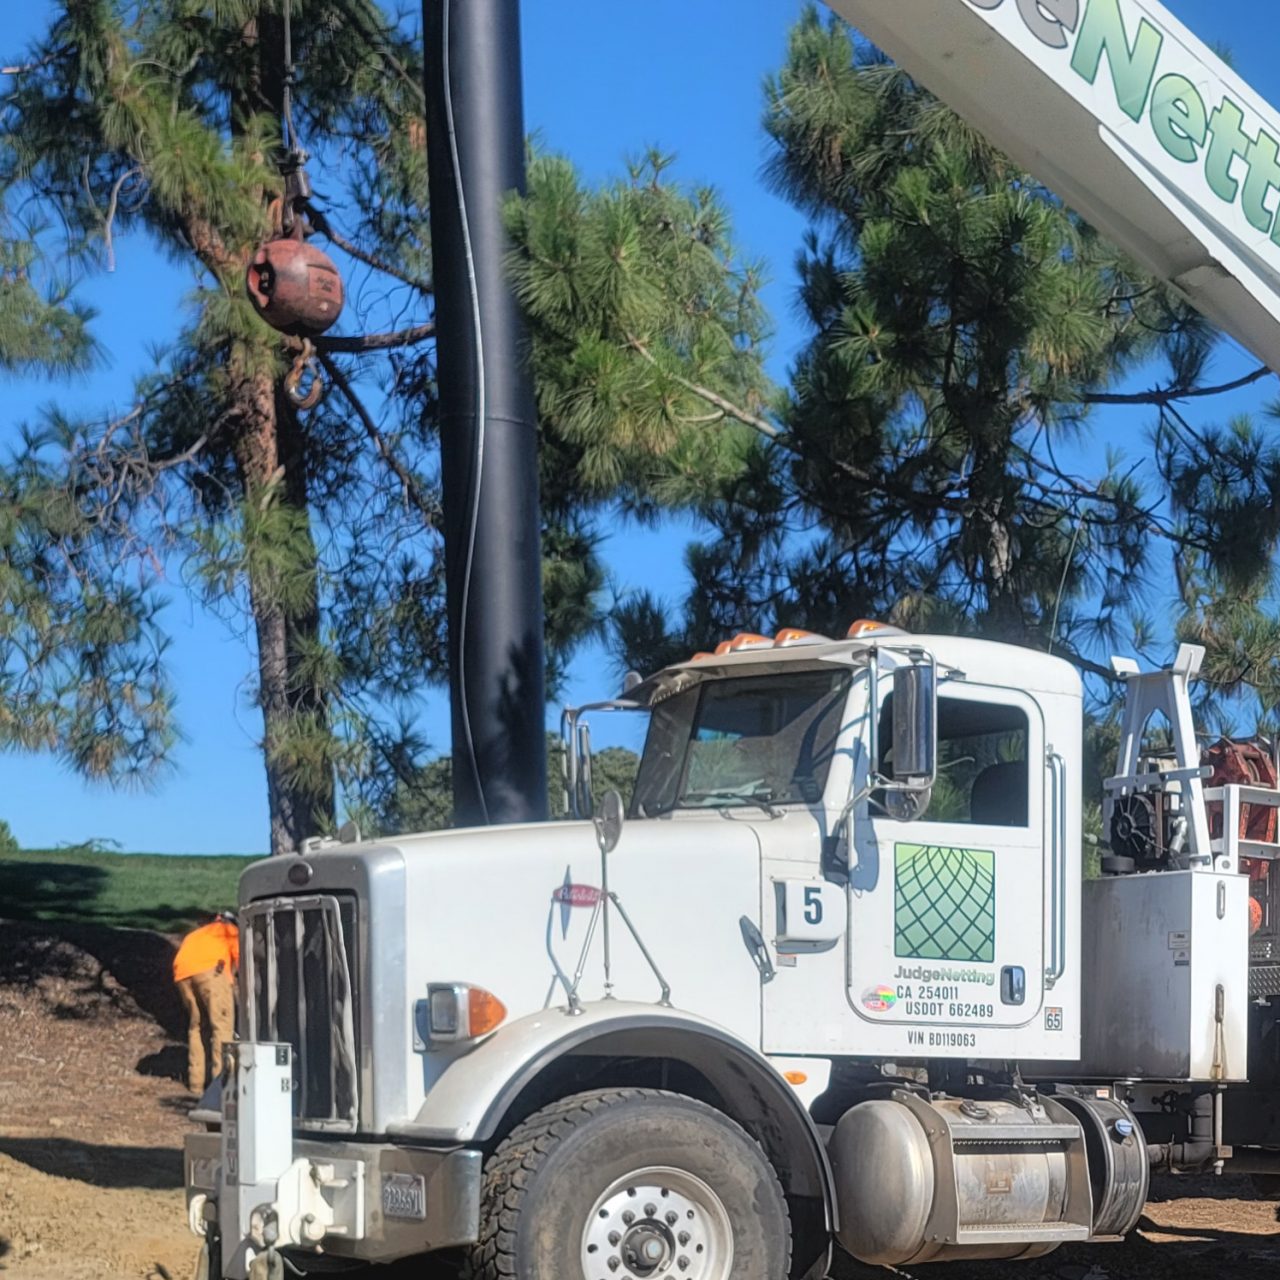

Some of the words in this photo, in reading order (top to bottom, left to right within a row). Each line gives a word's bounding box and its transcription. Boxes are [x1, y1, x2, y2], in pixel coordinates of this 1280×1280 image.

[803, 886, 823, 925] 5
[894, 965, 995, 986] JudgeNetting
[896, 985, 912, 999] CA
[918, 986, 958, 1000] 254011
[905, 1001, 944, 1016] USDOT
[949, 1003, 994, 1018] 662489
[1046, 1013, 1060, 1028] 65
[907, 1030, 924, 1045] VIN
